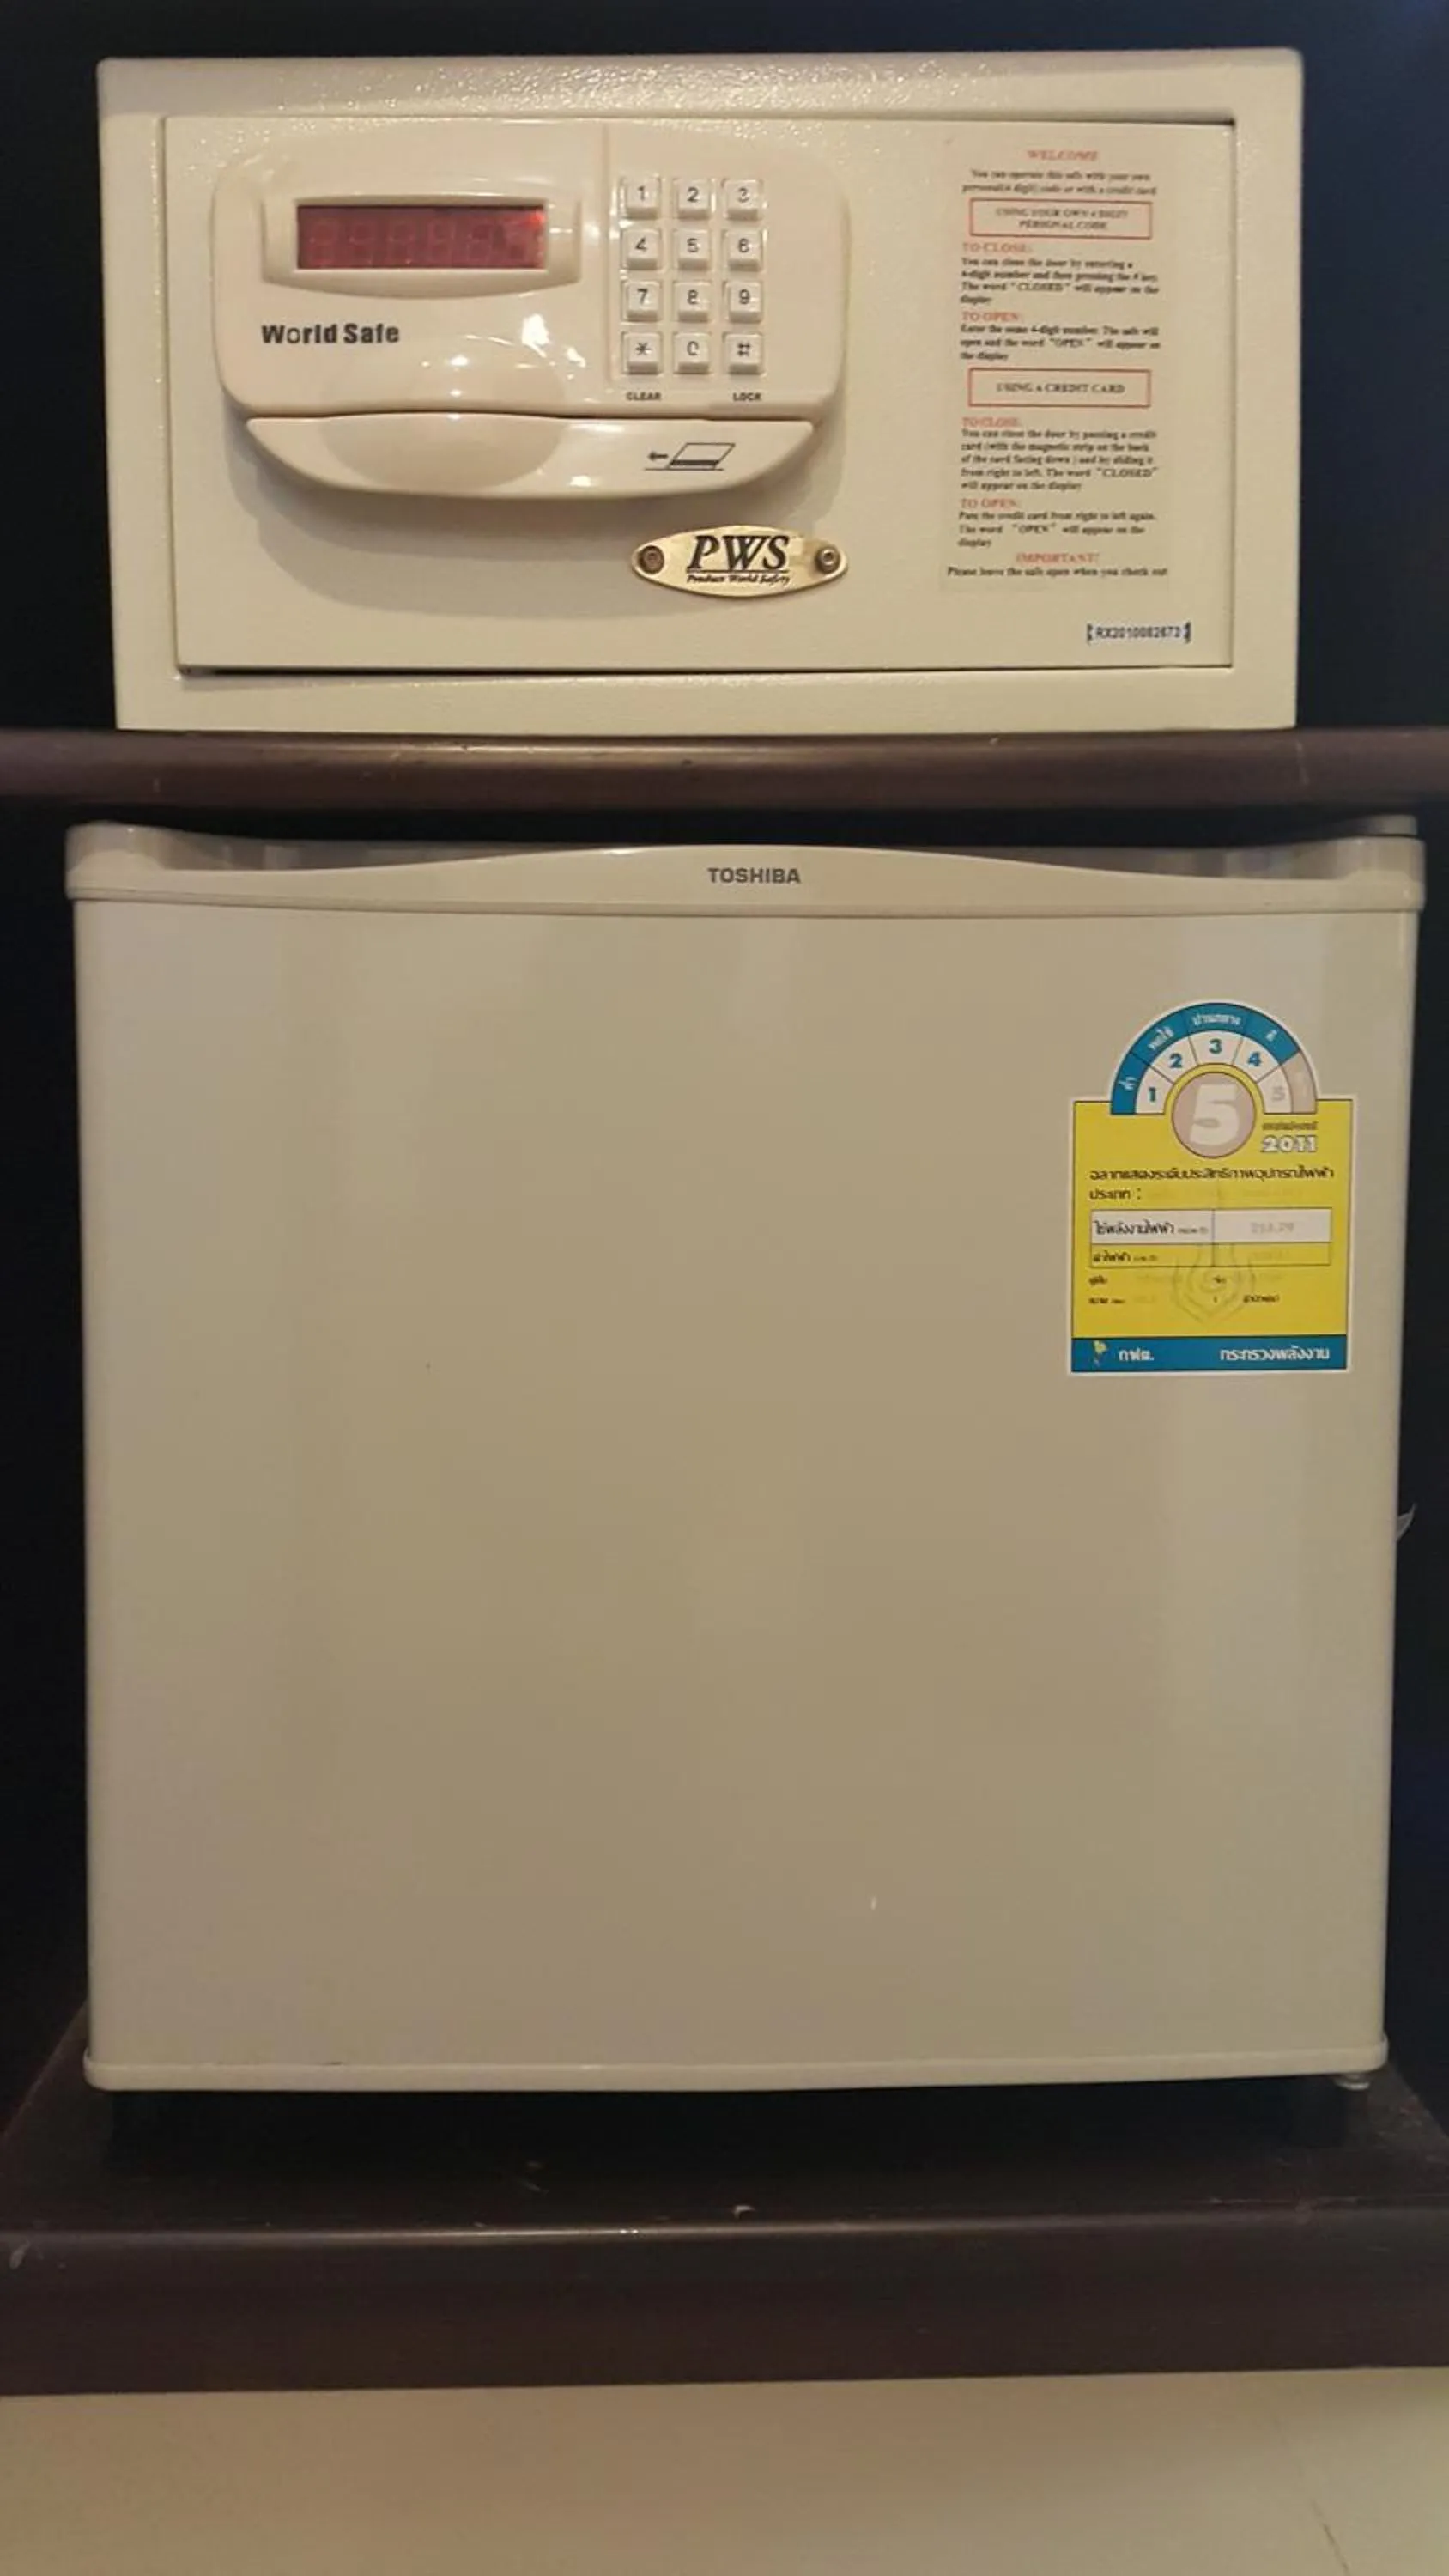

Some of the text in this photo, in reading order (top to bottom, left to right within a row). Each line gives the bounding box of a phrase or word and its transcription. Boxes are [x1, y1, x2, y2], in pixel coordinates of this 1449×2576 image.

[1028, 151, 1098, 161] WELCOME
[971, 170, 988, 179] You
[1009, 172, 1043, 180] operate
[1109, 173, 1129, 182] your
[638, 186, 749, 203] 1 2 3
[1019, 221, 1073, 229] PERSONAL
[635, 238, 749, 252] 4 5 6
[962, 244, 981, 252] TO
[1046, 258, 1066, 267] door
[1070, 259, 1082, 269] by
[1085, 261, 1125, 270] entering
[1076, 273, 1113, 282] pressing
[962, 282, 979, 290] The
[1075, 283, 1092, 292] will
[637, 289, 750, 304] 7 8 9
[960, 295, 992, 305] display
[962, 313, 980, 321] TO
[262, 323, 399, 345] World Safe
[687, 341, 750, 356] 0 #
[961, 339, 981, 348] open
[1116, 341, 1146, 349] appear
[977, 352, 1008, 361] display
[997, 383, 1125, 392] USING CREDIT CARD
[627, 392, 662, 401] CLEAR
[733, 392, 761, 401] LOCK
[962, 417, 980, 427] TO
[1070, 430, 1079, 439] by
[961, 442, 981, 451] card
[1028, 443, 1069, 453] magnetic
[1073, 443, 1094, 453] strip
[1128, 443, 1149, 452] back
[990, 455, 1010, 464] card
[1015, 455, 1042, 465] facing
[1113, 456, 1143, 465] sliding
[987, 469, 1009, 478] right
[981, 483, 1014, 491] appear
[1048, 482, 1082, 491] display
[961, 499, 977, 508] TO
[1076, 513, 1097, 522] right
[1082, 527, 1113, 536] appear
[958, 538, 991, 548] display
[688, 535, 790, 570] PWS
[947, 568, 977, 576] Please
[979, 568, 1003, 576] leave
[1008, 568, 1022, 576] the
[1025, 568, 1043, 576] safe
[1046, 569, 1069, 578] open
[1073, 568, 1096, 576] when
[1101, 569, 1117, 578] you
[707, 868, 801, 883] TOSHIBA
[1209, 1039, 1222, 1054] 3
[1170, 1054, 1183, 1068] 2
[1247, 1052, 1262, 1066] 4
[1149, 1088, 1155, 1102] 1
[1190, 1083, 1240, 1145] 5
[1261, 1136, 1317, 1152] 2011
